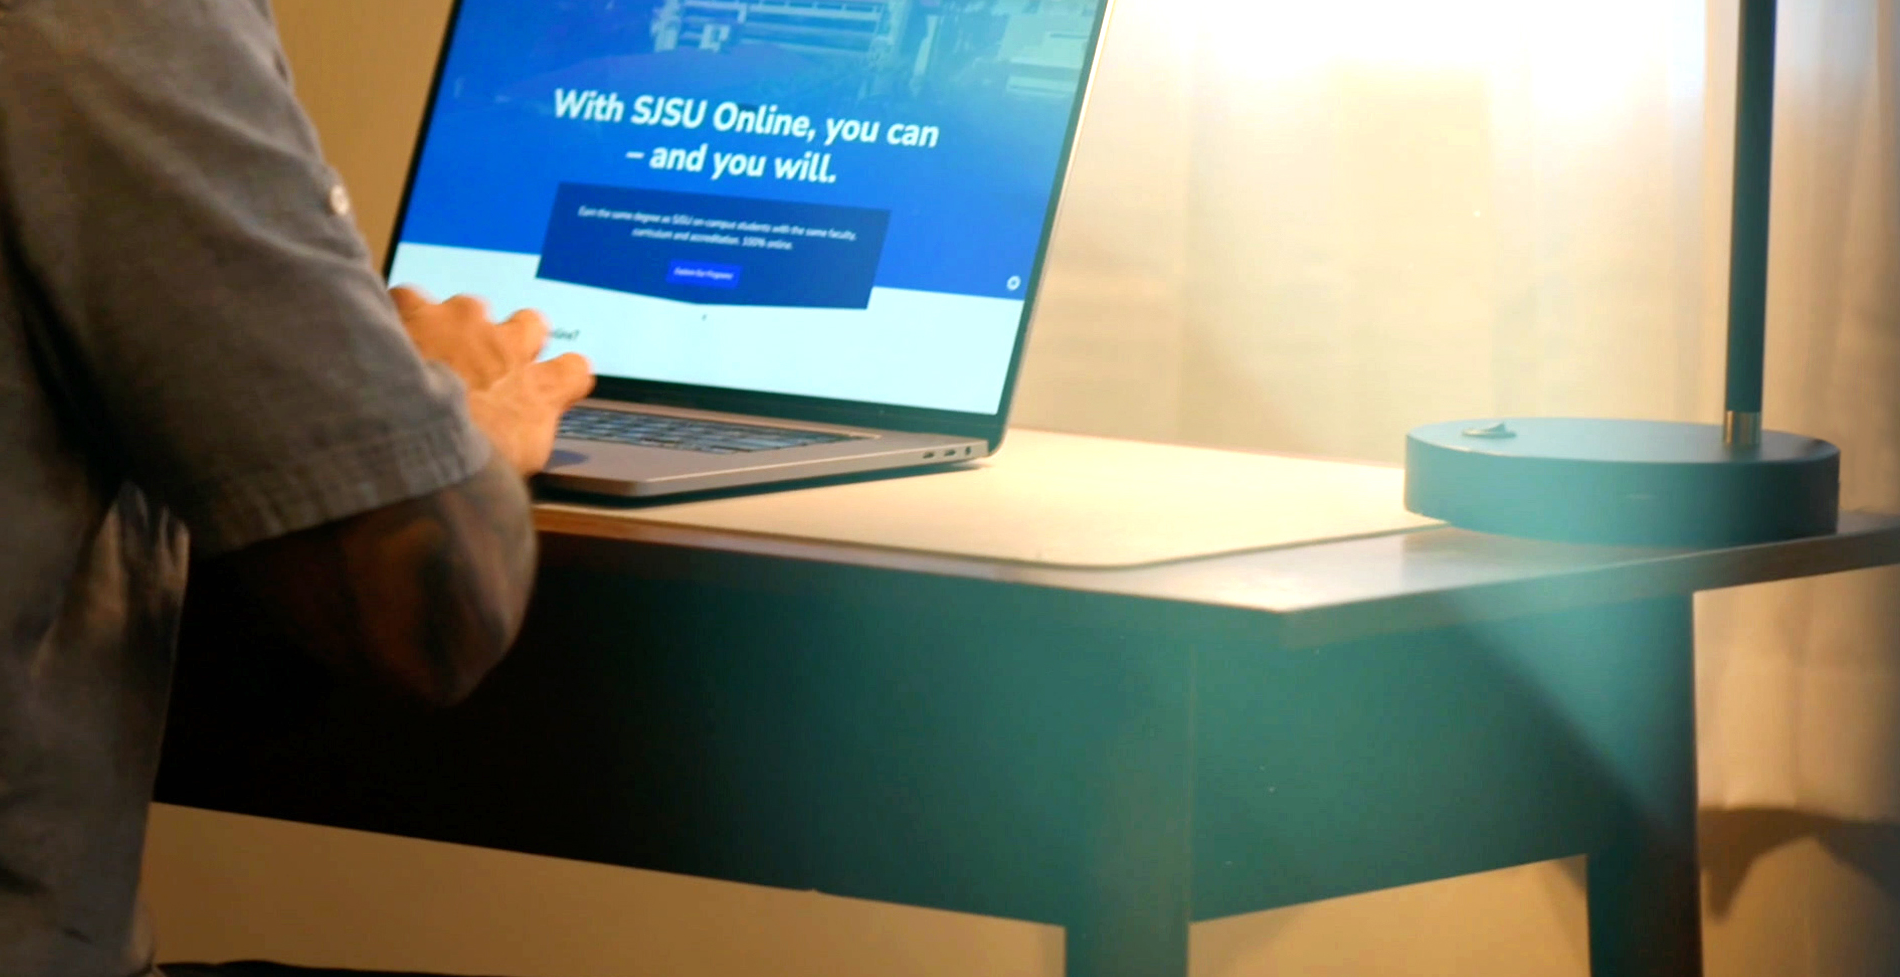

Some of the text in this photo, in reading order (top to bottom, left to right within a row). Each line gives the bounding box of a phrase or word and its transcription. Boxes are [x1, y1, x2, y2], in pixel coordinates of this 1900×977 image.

[553, 88, 939, 148] With SJSU Online, you can
[649, 143, 708, 172] and
[711, 150, 766, 180] you
[774, 152, 837, 183] will.
[597, 208, 611, 218] the
[611, 210, 633, 221] same
[633, 212, 661, 224] degree
[672, 213, 693, 226] SJSU
[737, 221, 771, 233] students
[805, 228, 827, 238] same
[673, 230, 690, 241] and
